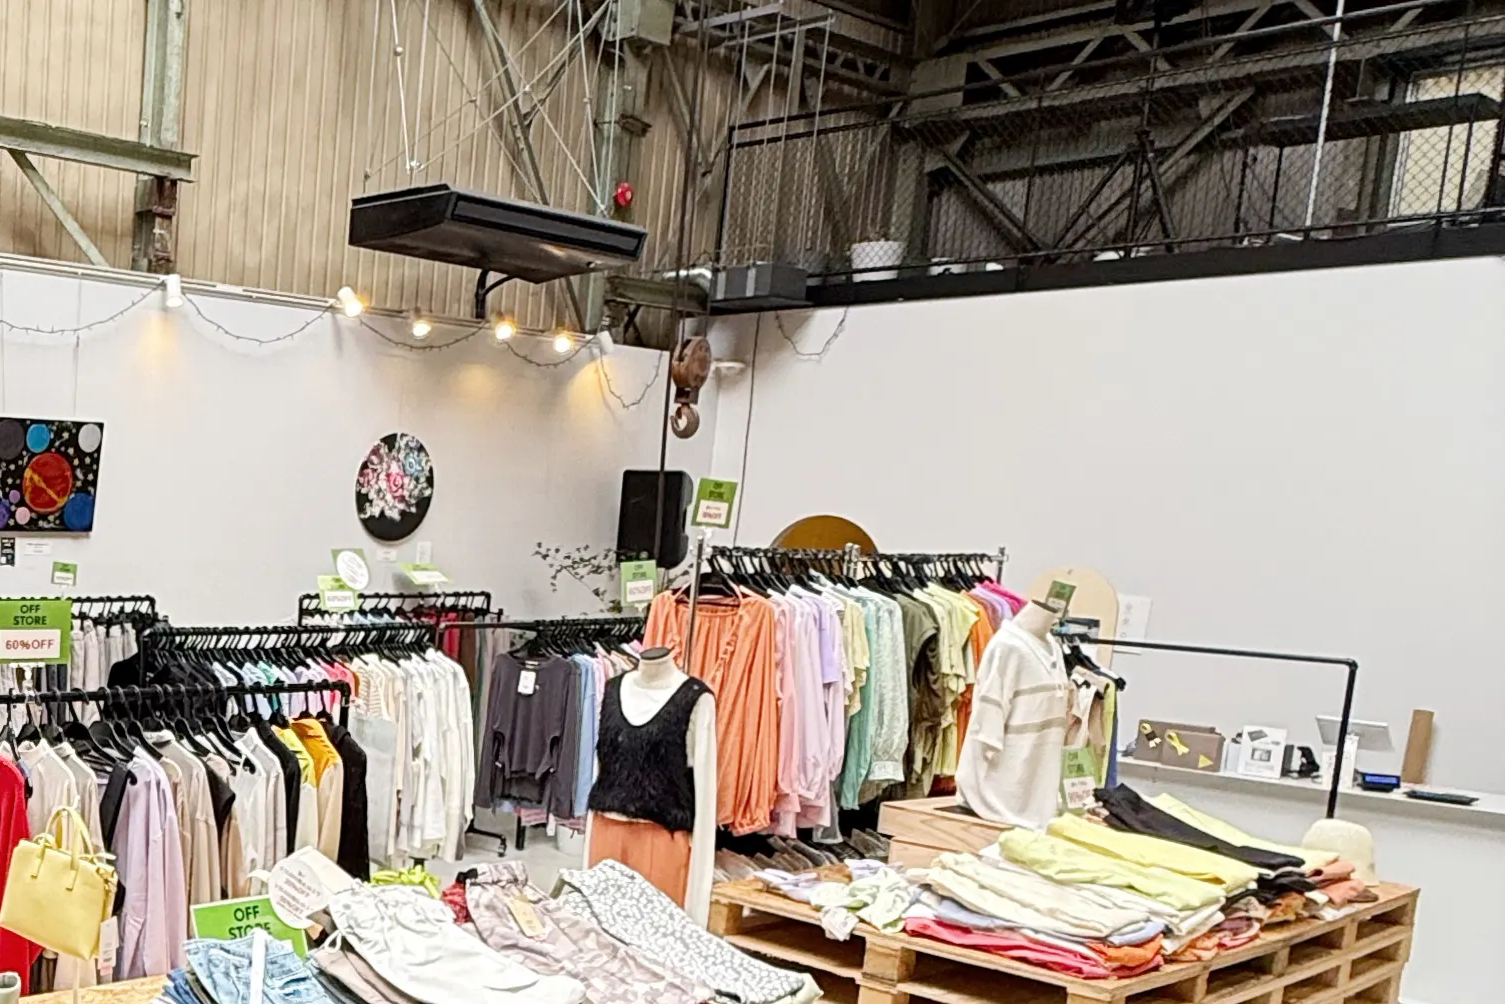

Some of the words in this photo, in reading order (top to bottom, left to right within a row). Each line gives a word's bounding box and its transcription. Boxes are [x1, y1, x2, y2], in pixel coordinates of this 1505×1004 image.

[20, 604, 41, 614] OFF
[13, 616, 47, 625] STORE
[5, 639, 54, 650] 60%OFF
[233, 905, 260, 922] OFF
